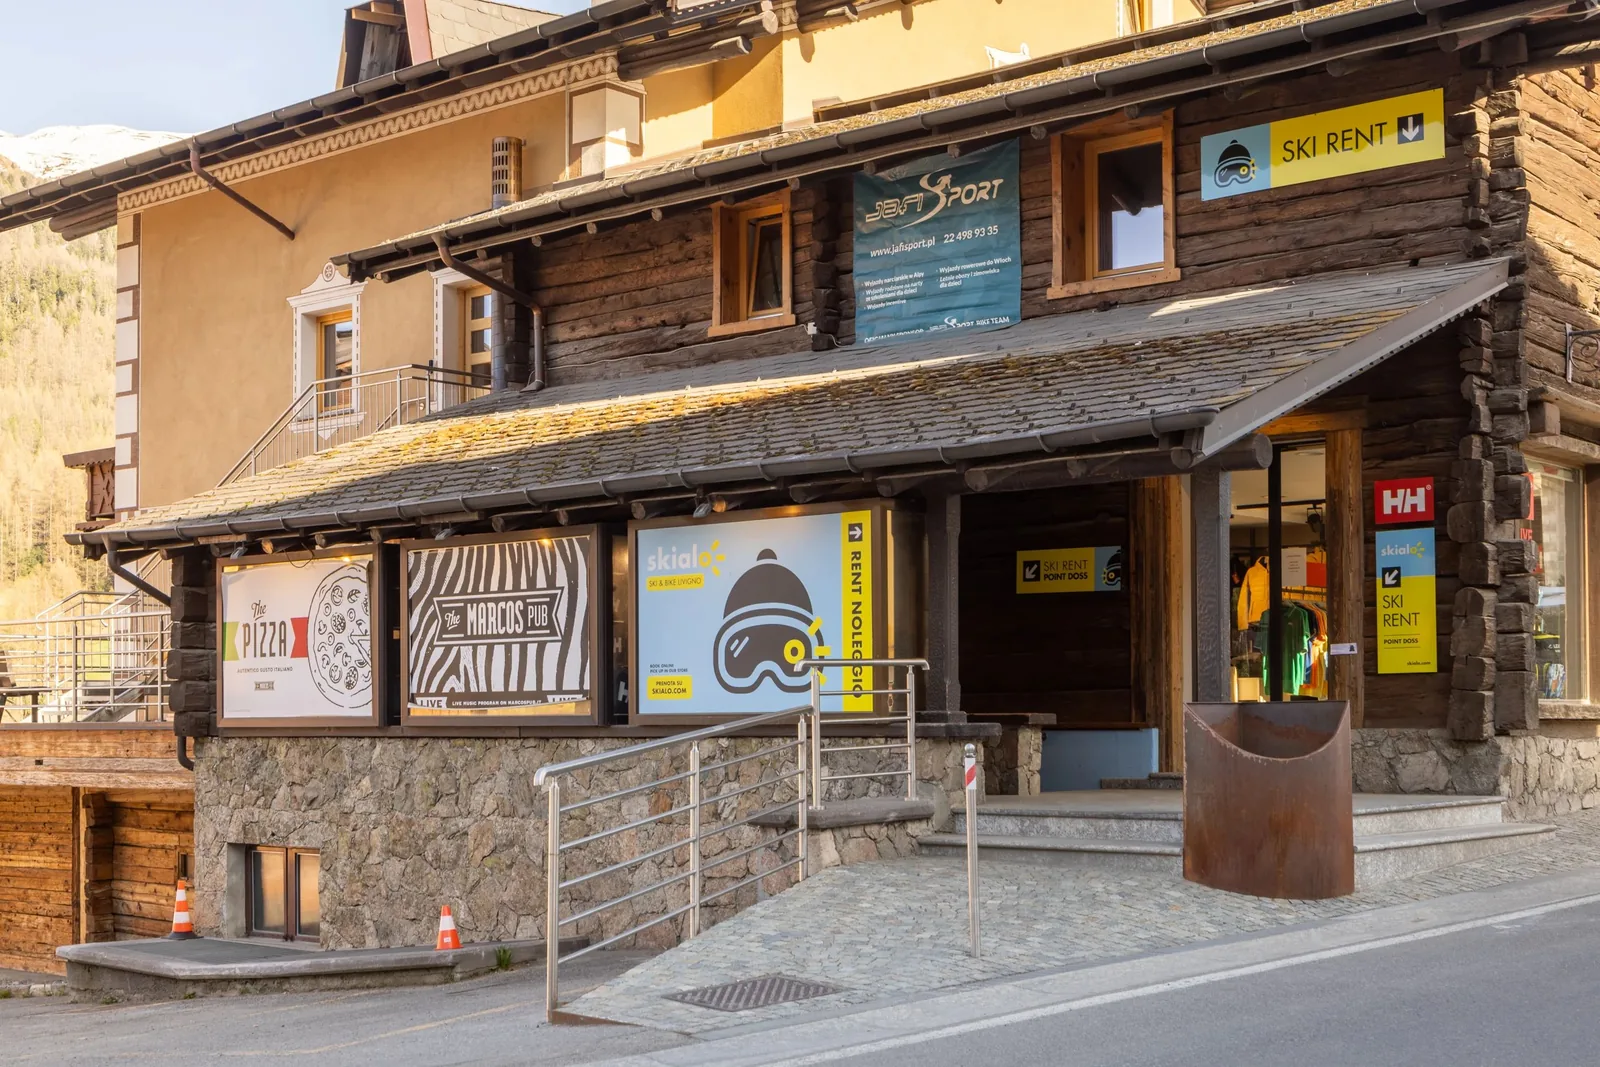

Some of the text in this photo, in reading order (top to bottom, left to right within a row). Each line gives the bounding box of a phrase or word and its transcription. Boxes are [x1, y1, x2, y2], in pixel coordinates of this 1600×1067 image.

[1282, 122, 1388, 163] SKI RENT
[870, 225, 999, 258] www.jafisport.pl 22 498 93 35
[990, 316, 1010, 324] TEAM
[647, 543, 713, 572] skialo
[1381, 543, 1418, 557] skialo
[851, 550, 862, 595] RENT
[1043, 559, 1088, 572] SKI RENT
[1067, 572, 1088, 580] DOSS
[1382, 594, 1403, 609] SKI
[251, 600, 268, 620] The
[444, 600, 548, 636] The MARCOS PUB
[1383, 612, 1420, 627] RENT
[242, 620, 287, 659] PIZZA
[652, 687, 687, 695] SKIALO.COM
[420, 699, 443, 708] LIVE
